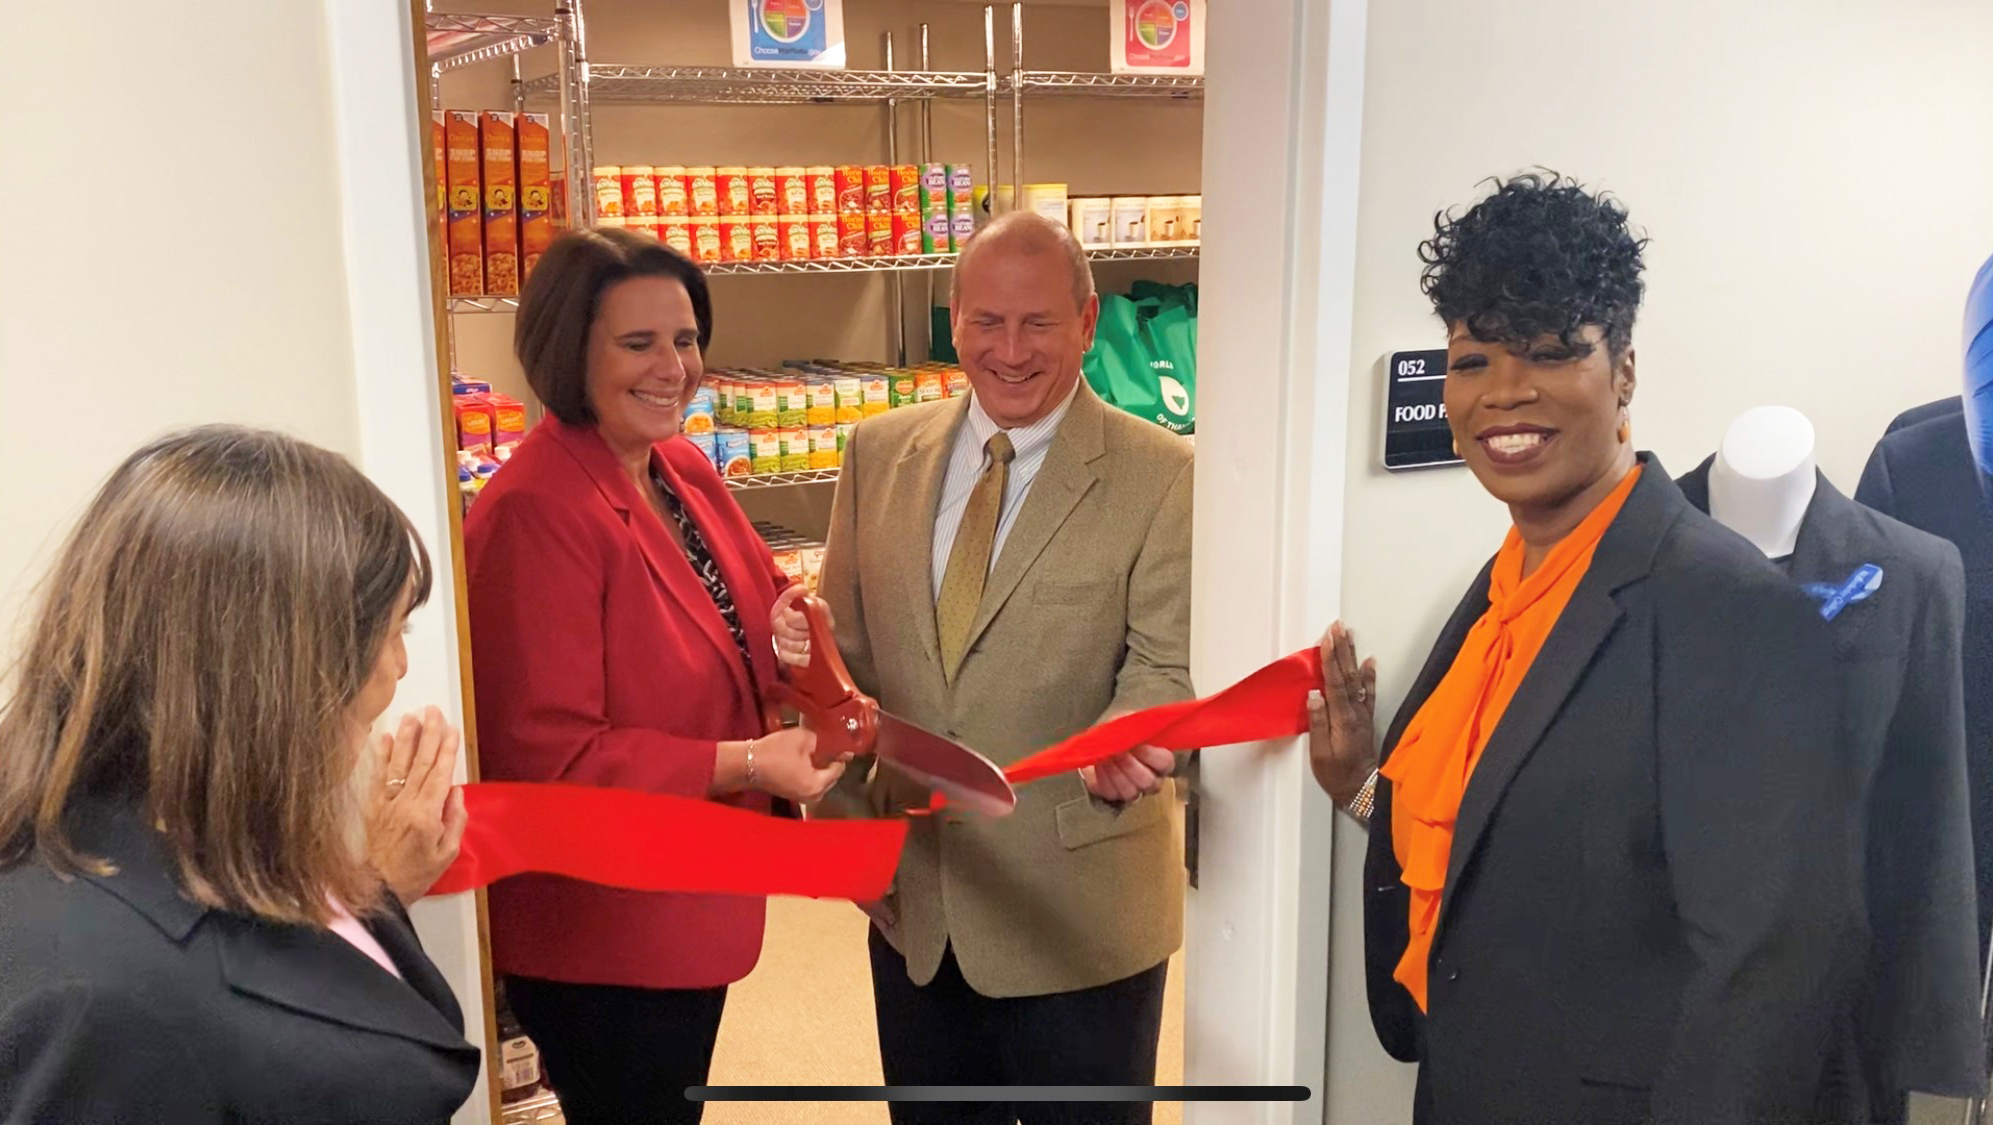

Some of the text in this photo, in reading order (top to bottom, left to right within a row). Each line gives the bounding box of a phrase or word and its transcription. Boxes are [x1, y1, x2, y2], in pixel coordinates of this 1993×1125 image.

[1398, 359, 1425, 376] 052
[1156, 413, 1168, 424] OF
[1395, 403, 1449, 422] FOOD P
